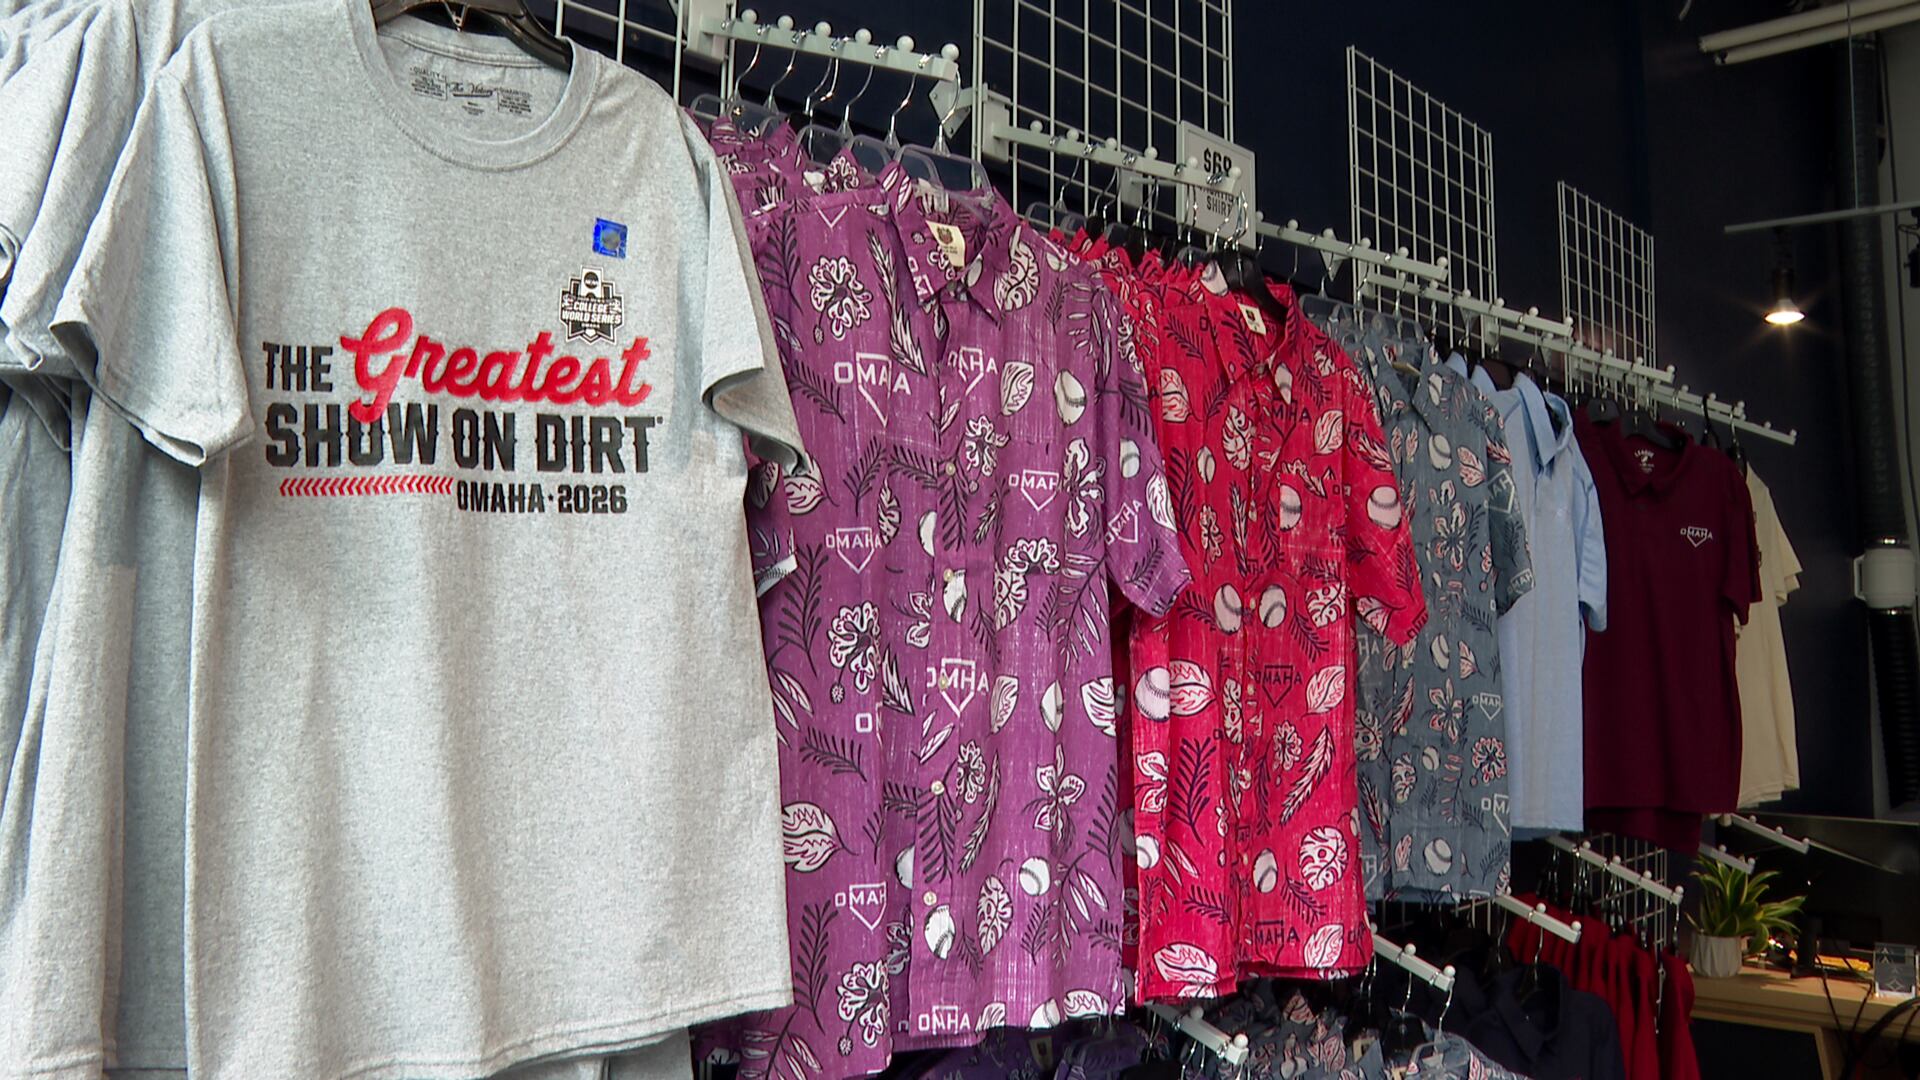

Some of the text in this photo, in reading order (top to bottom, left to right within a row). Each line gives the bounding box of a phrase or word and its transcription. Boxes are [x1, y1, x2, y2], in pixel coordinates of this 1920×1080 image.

[573, 300, 609, 313] COLLEGE
[561, 310, 622, 324] WORLD SERIES
[262, 306, 653, 424] THE Greatest
[947, 351, 998, 375] OHA
[834, 361, 912, 395] OMAA
[265, 402, 439, 468] SHOW
[452, 407, 518, 472] ON
[1008, 473, 1059, 490] OMAH
[456, 480, 628, 514] OMAHA 2026
[825, 533, 883, 549] OMAHA
[1680, 527, 1713, 540] OMAHA
[926, 666, 990, 692] OMHA
[835, 890, 887, 907] OMAH
[1256, 927, 1300, 945] MAHA
[918, 1012, 971, 1031] OMHA
